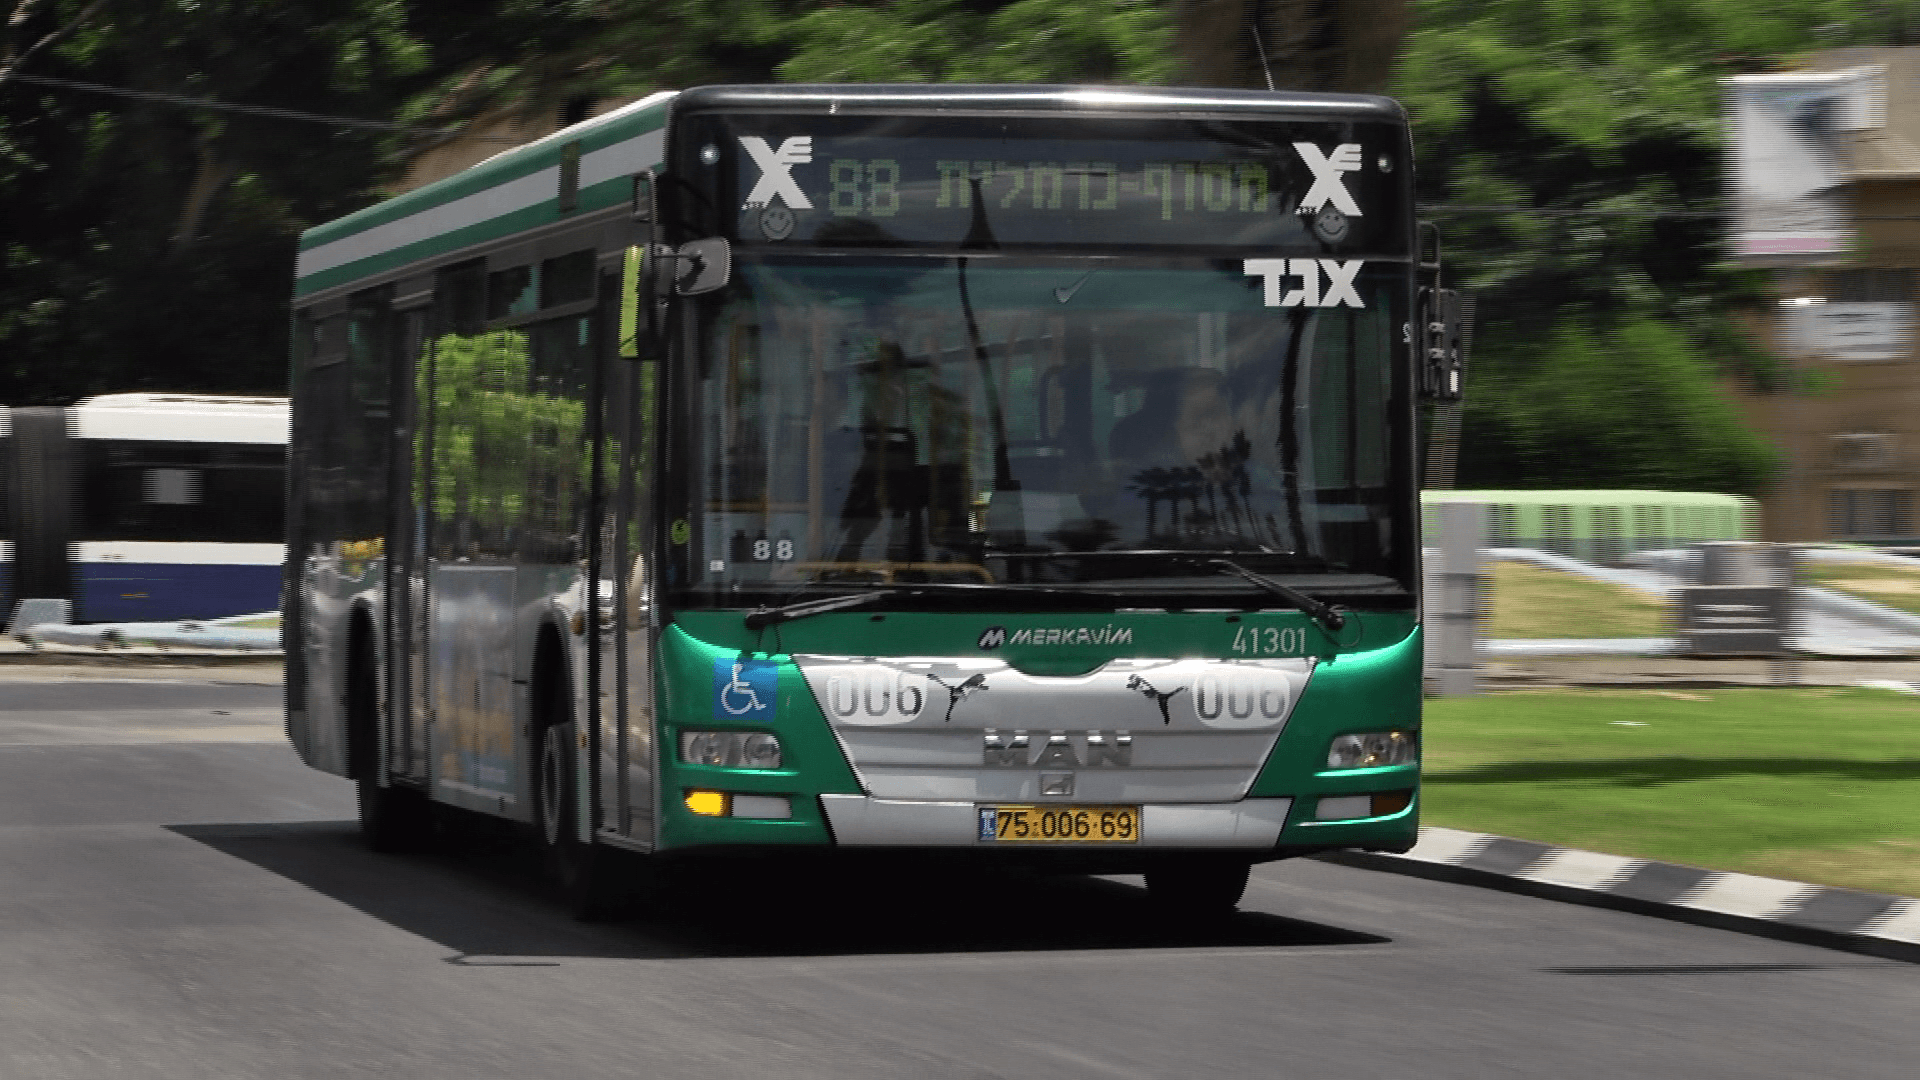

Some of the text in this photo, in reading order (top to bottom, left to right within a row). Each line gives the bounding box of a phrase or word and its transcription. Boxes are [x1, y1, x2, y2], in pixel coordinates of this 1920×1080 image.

[830, 159, 900, 216] 88
[753, 539, 794, 560] 88
[1232, 626, 1306, 655] 41301
[984, 729, 1132, 766] MAN
